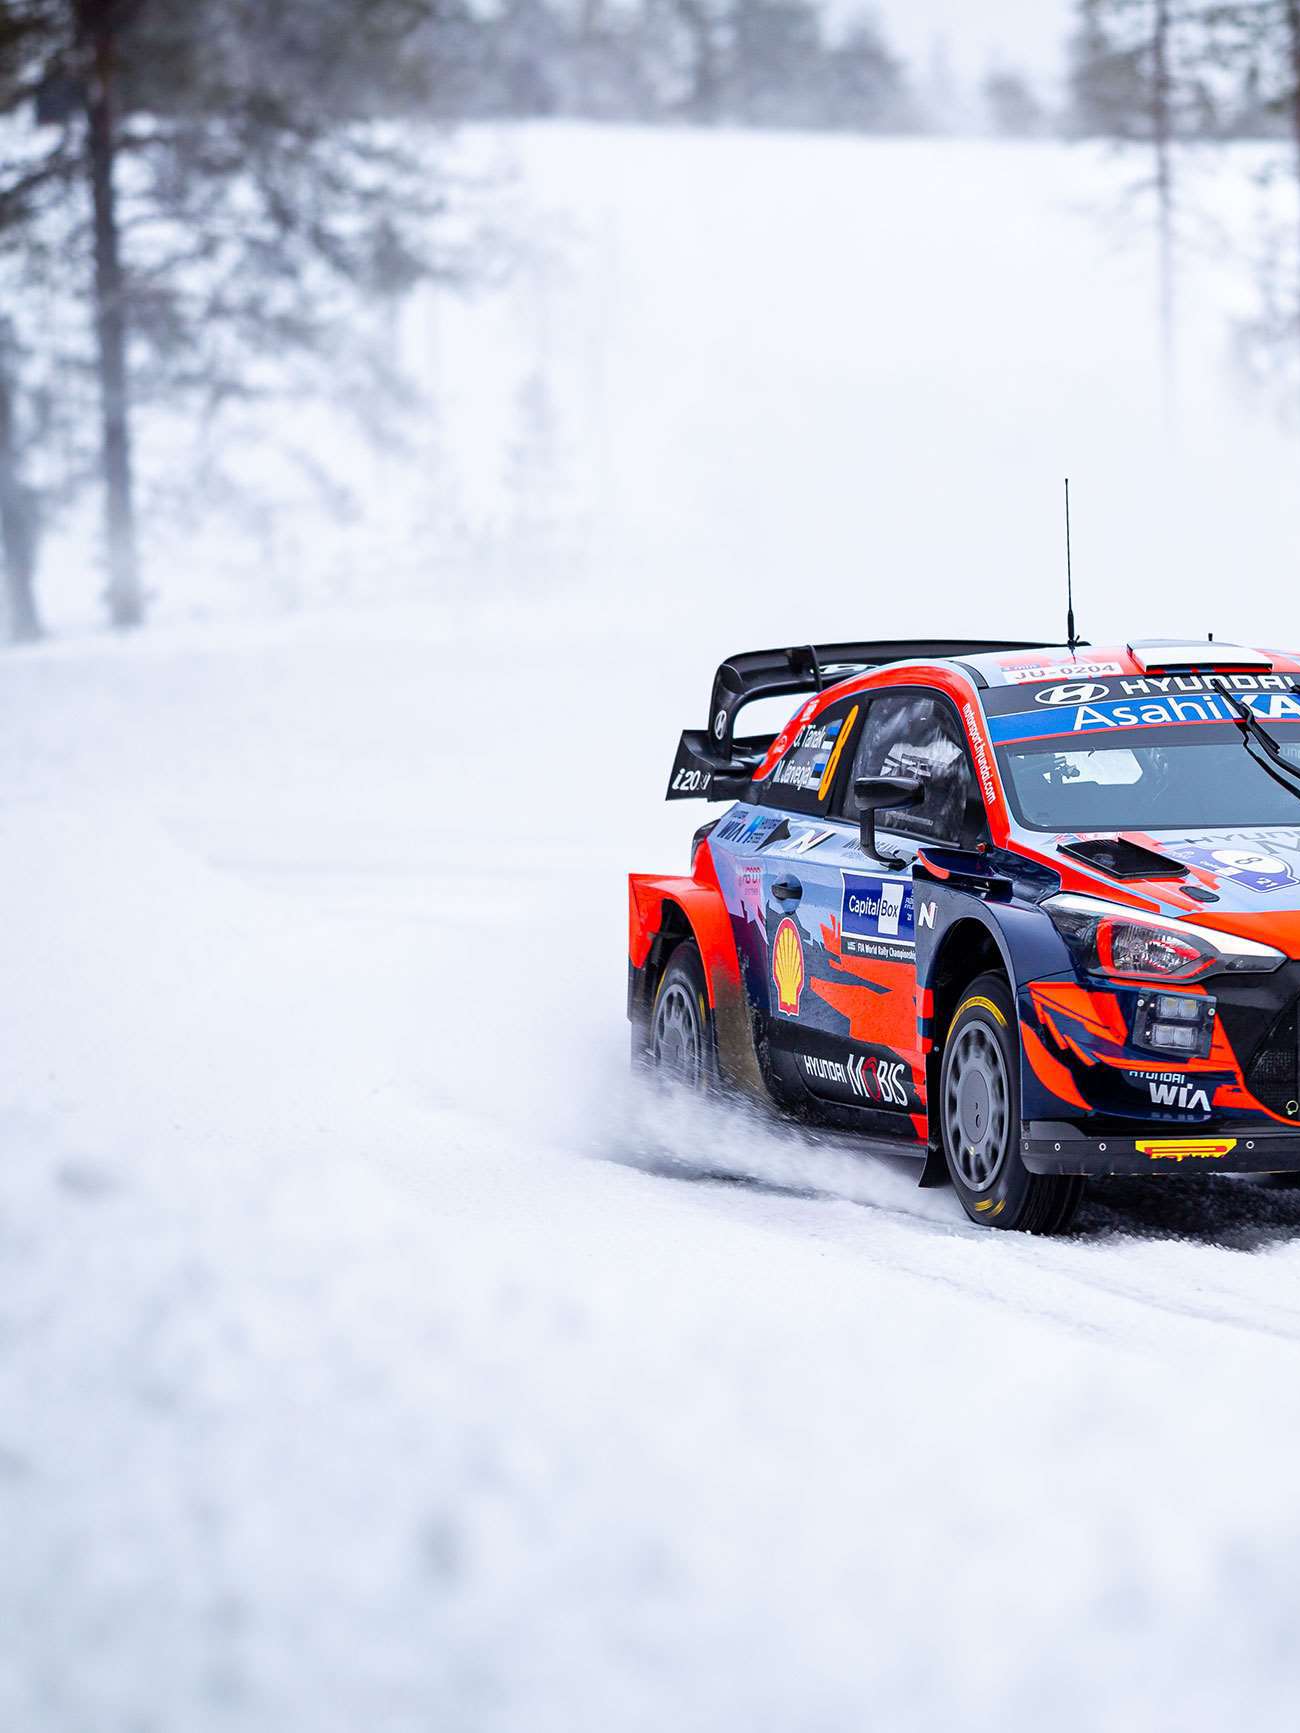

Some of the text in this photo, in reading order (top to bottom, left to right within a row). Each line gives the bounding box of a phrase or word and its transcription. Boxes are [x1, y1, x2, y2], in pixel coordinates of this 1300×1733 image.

[1015, 663, 1115, 680] JU-0204
[1120, 675, 1295, 695] HYUNDAI
[962, 702, 996, 805] motorsport.hyundai.com
[803, 1054, 848, 1084] HYUNDAI
[846, 1053, 909, 1107] MOBIS
